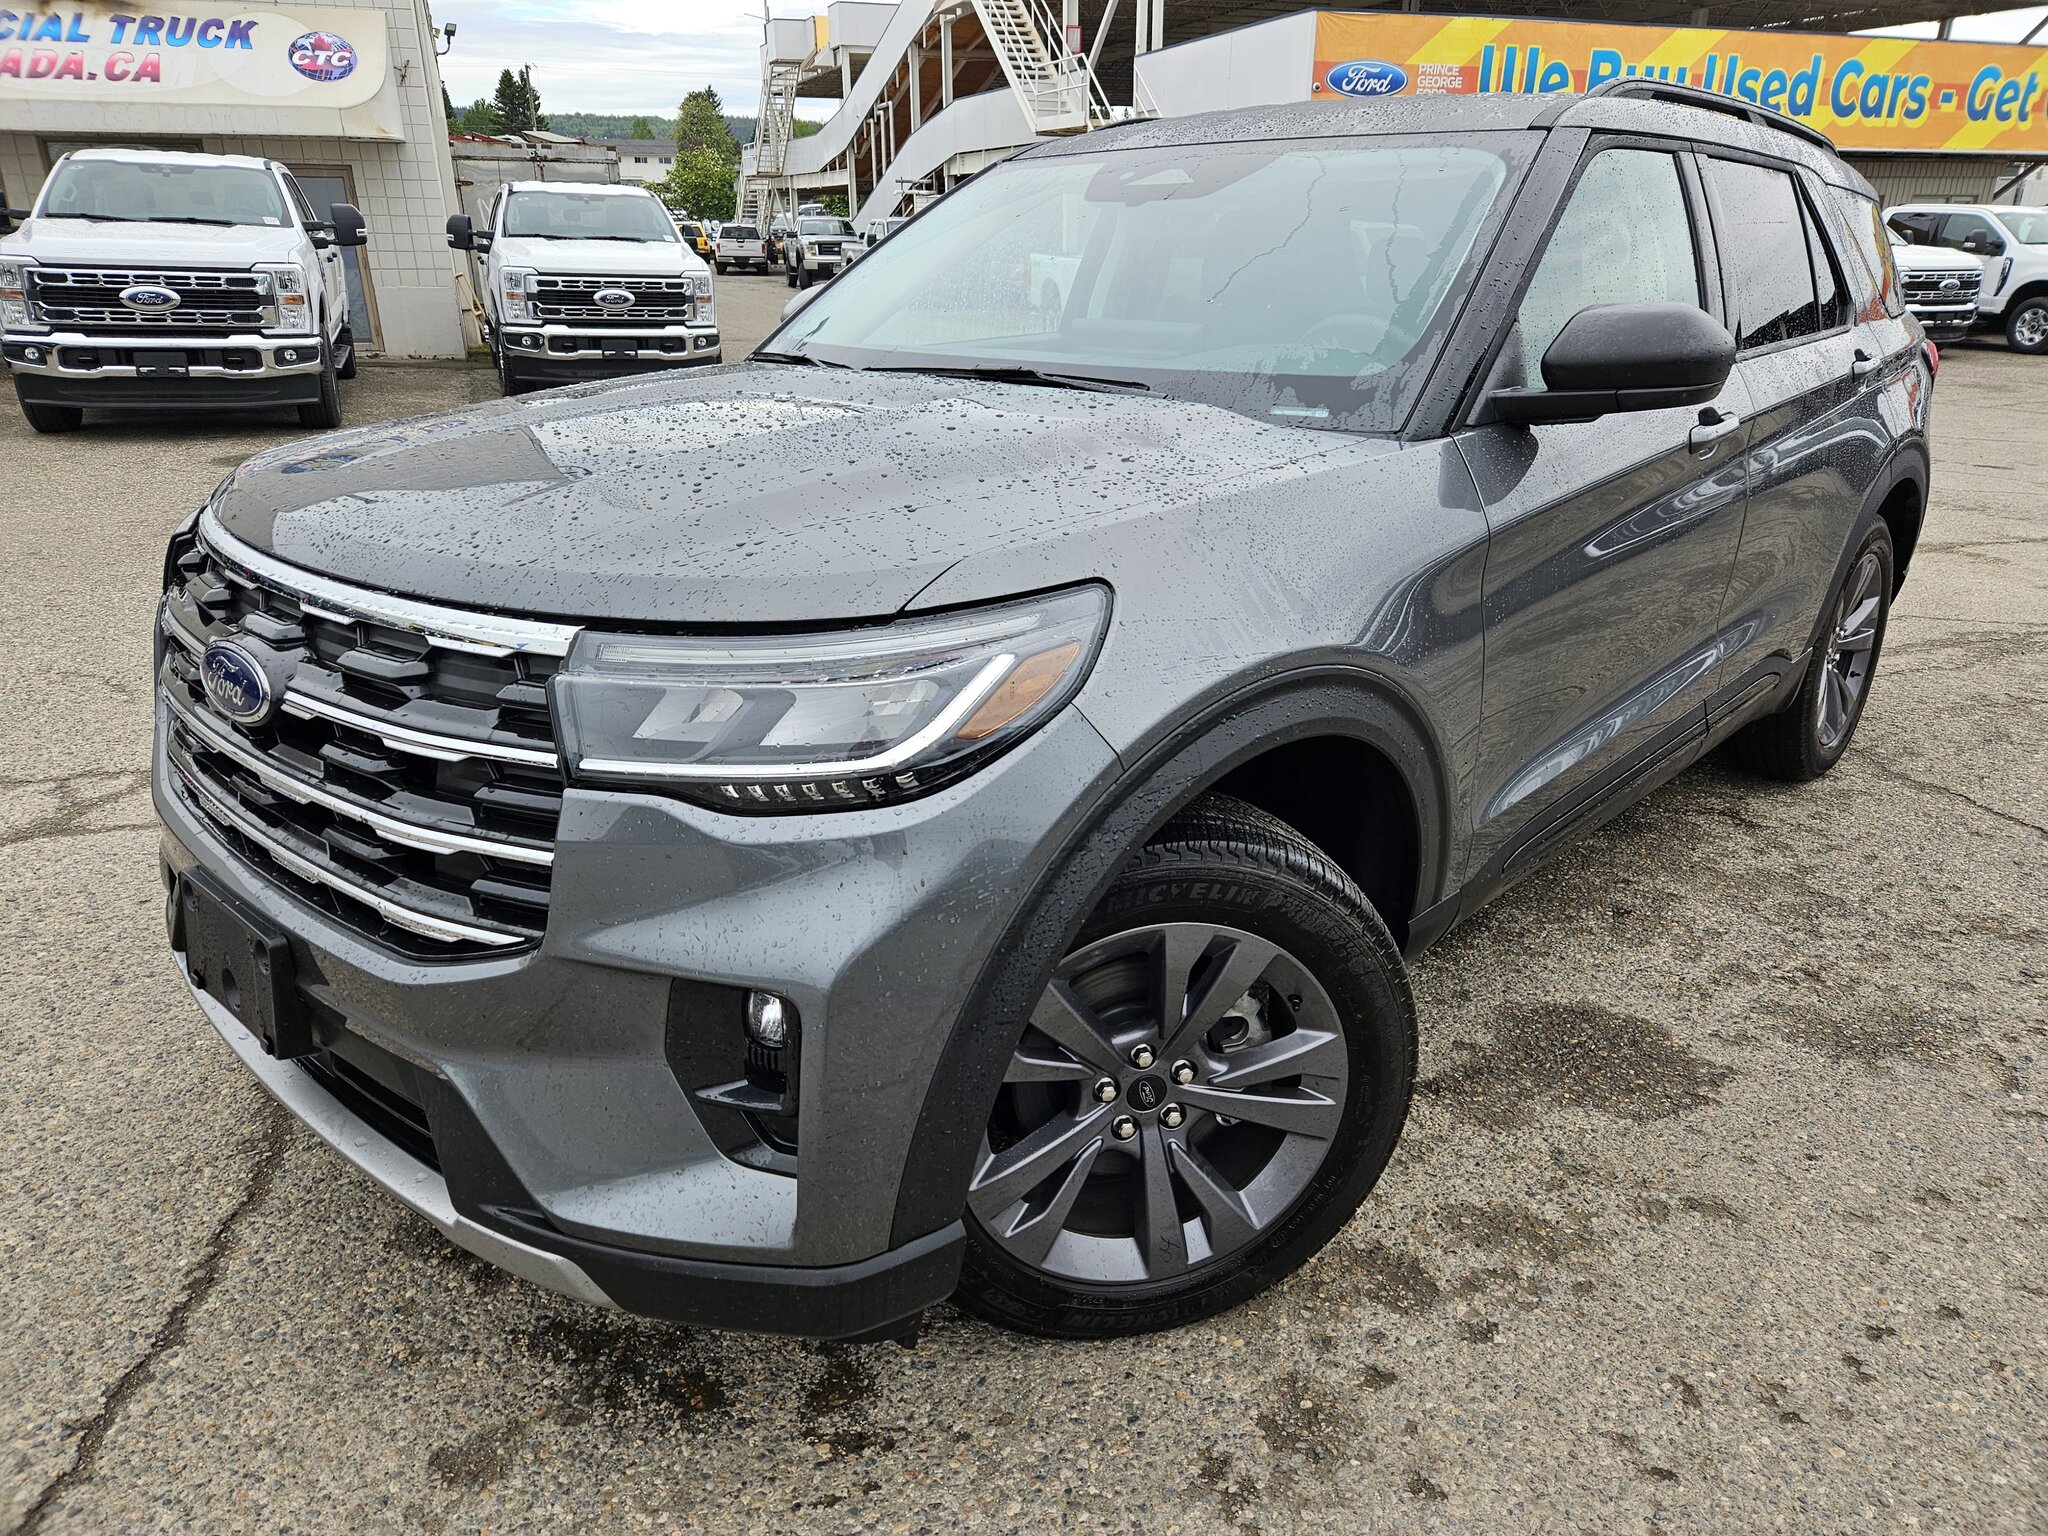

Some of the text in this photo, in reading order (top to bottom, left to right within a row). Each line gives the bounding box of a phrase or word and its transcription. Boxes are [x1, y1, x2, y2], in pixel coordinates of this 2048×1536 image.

[109, 14, 259, 50] TRUCK
[0, 47, 162, 83] ADA.CA
[291, 50, 354, 68] CTC
[1418, 63, 1460, 76] PRINCE
[1341, 65, 1393, 93] Ford
[1417, 75, 1463, 89] GEORGE
[1479, 44, 1570, 94] We
[1701, 54, 1823, 117] Used
[1830, 58, 1931, 120] Cars
[1966, 64, 2039, 123] Get
[135, 291, 164, 304] Ford
[604, 294, 625, 304] Ford
[207, 655, 248, 706] Ford
